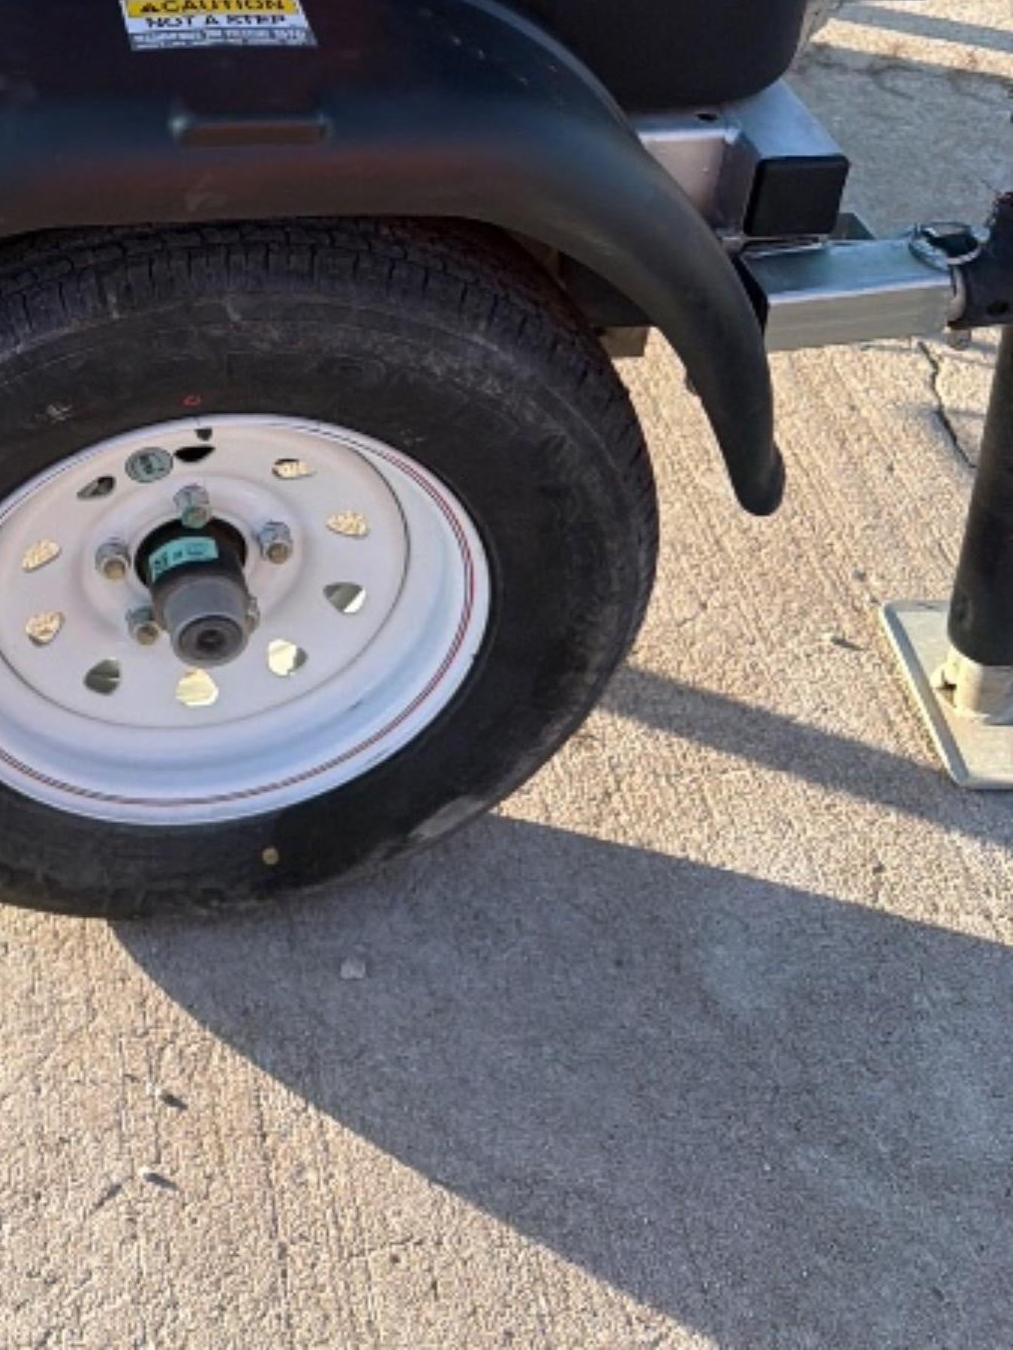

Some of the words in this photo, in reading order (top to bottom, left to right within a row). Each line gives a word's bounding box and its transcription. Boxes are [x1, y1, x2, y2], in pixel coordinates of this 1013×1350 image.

[146, 16, 194, 29] NOT
[205, 14, 220, 26] A
[226, 13, 285, 26] STEP
